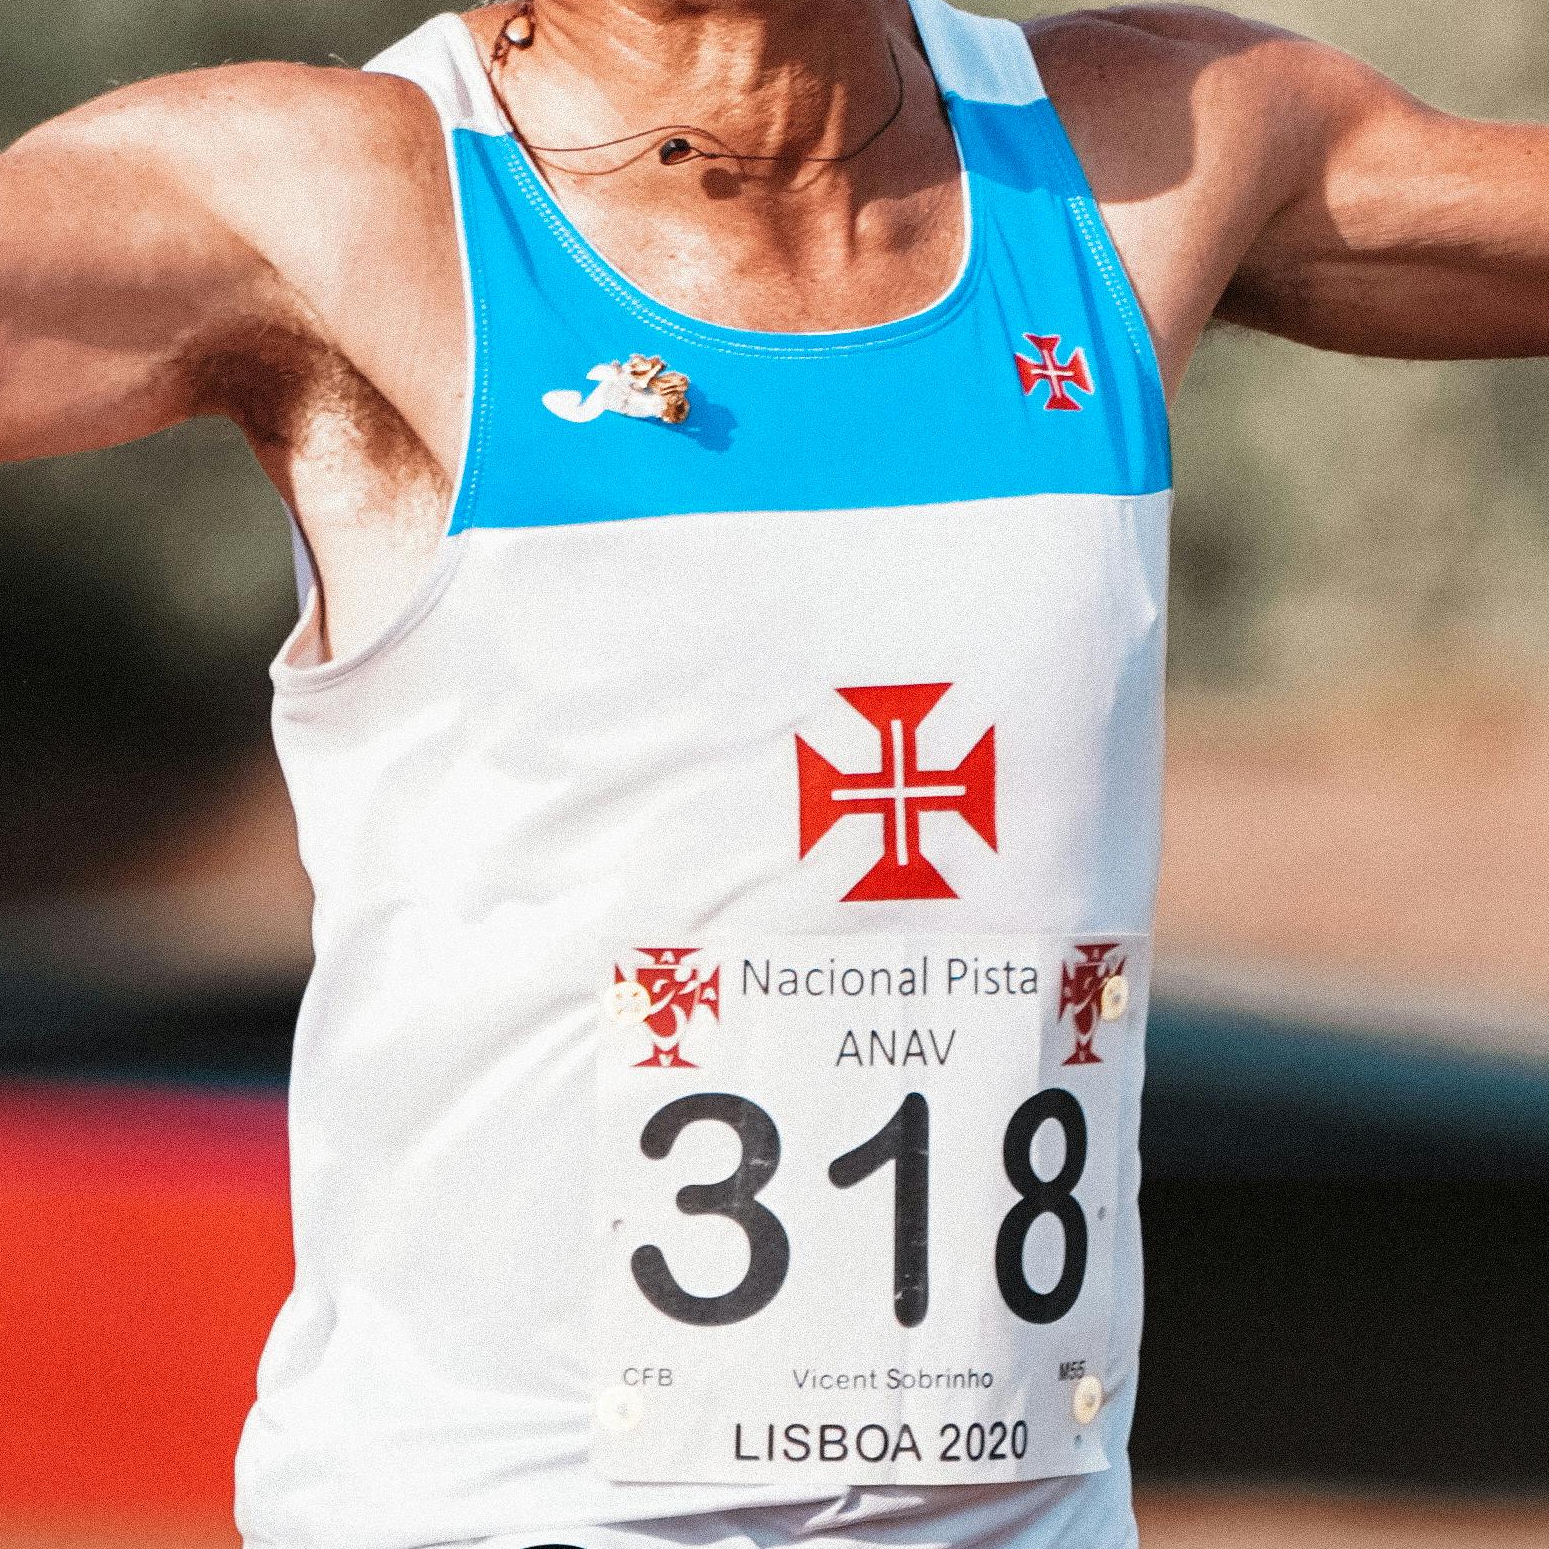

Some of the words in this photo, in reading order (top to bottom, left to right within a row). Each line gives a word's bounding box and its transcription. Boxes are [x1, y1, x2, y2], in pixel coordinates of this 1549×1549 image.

[742, 956, 928, 998] Nacional
[947, 955, 1040, 997] Pista
[835, 1029, 957, 1067] ANAV
[629, 1087, 1089, 1329] 318
[622, 1367, 674, 1387] CFB
[792, 1368, 878, 1390] Vicent
[886, 1367, 995, 1390] Sobrinho
[733, 1422, 924, 1463] LISBOA
[939, 1420, 1029, 1463] 2020
